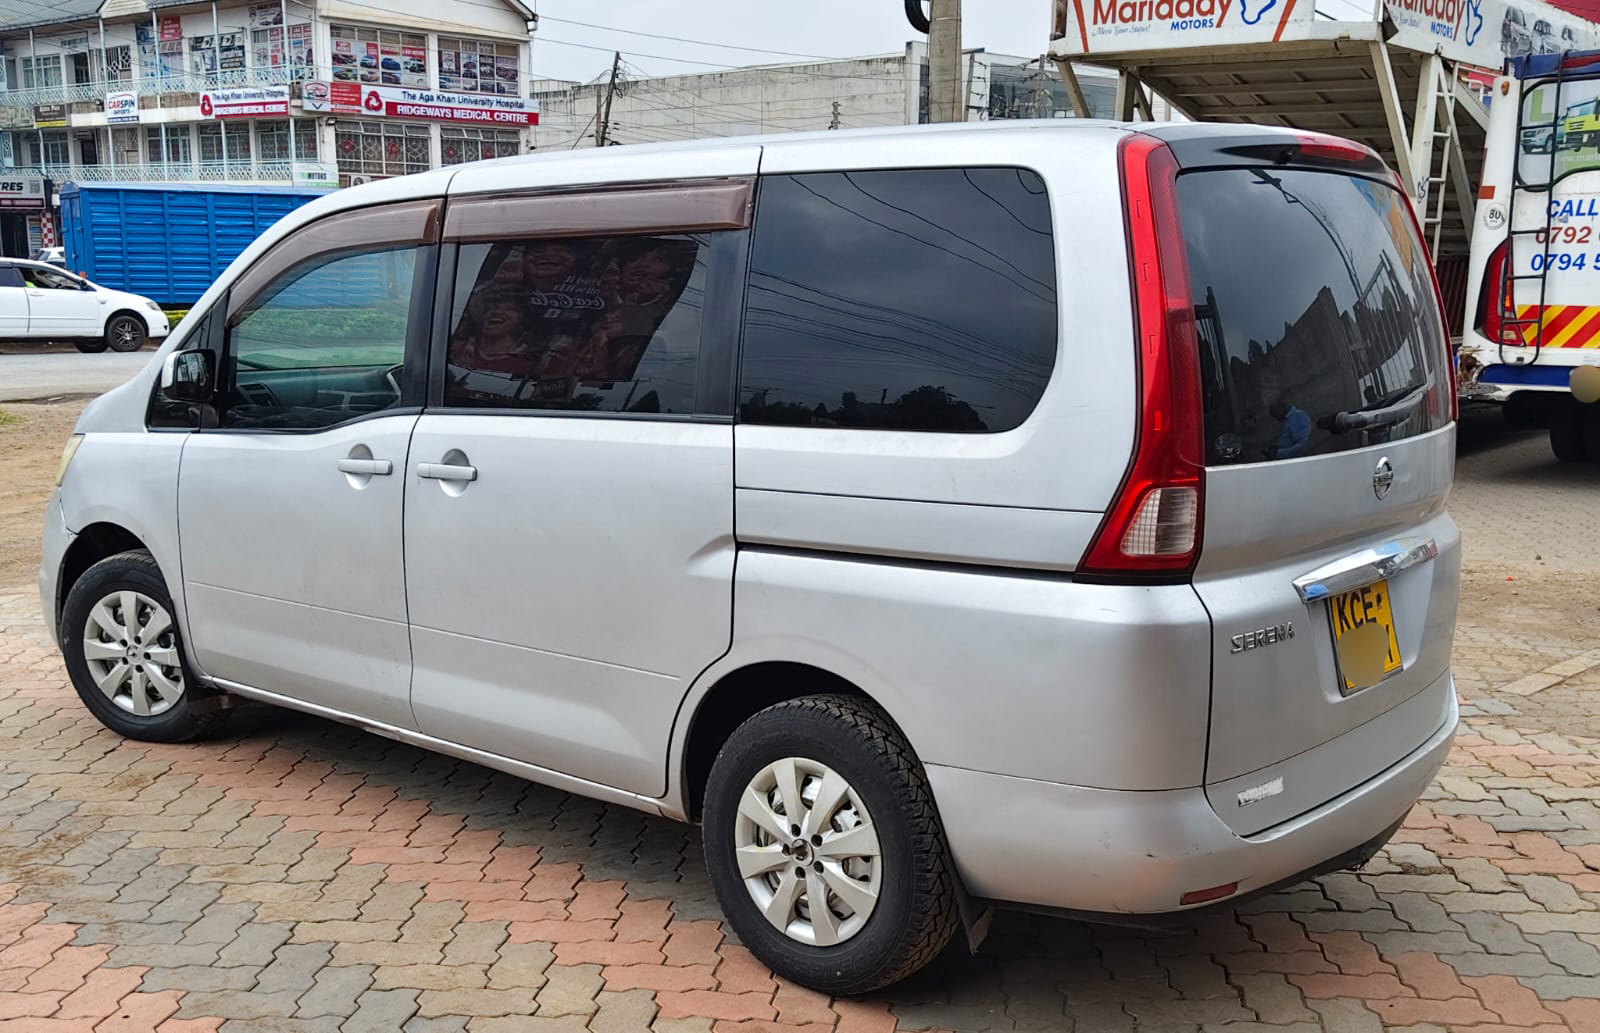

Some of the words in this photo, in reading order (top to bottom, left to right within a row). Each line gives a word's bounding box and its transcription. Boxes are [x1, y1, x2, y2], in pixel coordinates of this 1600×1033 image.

[1171, 18, 1214, 31] MOTORS
[1430, 21, 1454, 39] MOTORS
[401, 91, 416, 100] The
[418, 92, 434, 103] Aga
[436, 93, 456, 103] Khan
[457, 95, 494, 108] University
[495, 98, 525, 109] Hospital
[397, 104, 452, 118] RIDGEWAYS
[453, 108, 493, 121] MEDICAL
[494, 111, 529, 124] CENTRE
[0, 182, 23, 191] RES
[1488, 209, 1501, 220] 80
[1546, 198, 1599, 218] CALL
[1535, 226, 1592, 244] 0792
[1530, 253, 1586, 271] 0794
[1336, 586, 1378, 634] KCE
[1230, 621, 1296, 654] SERENA
